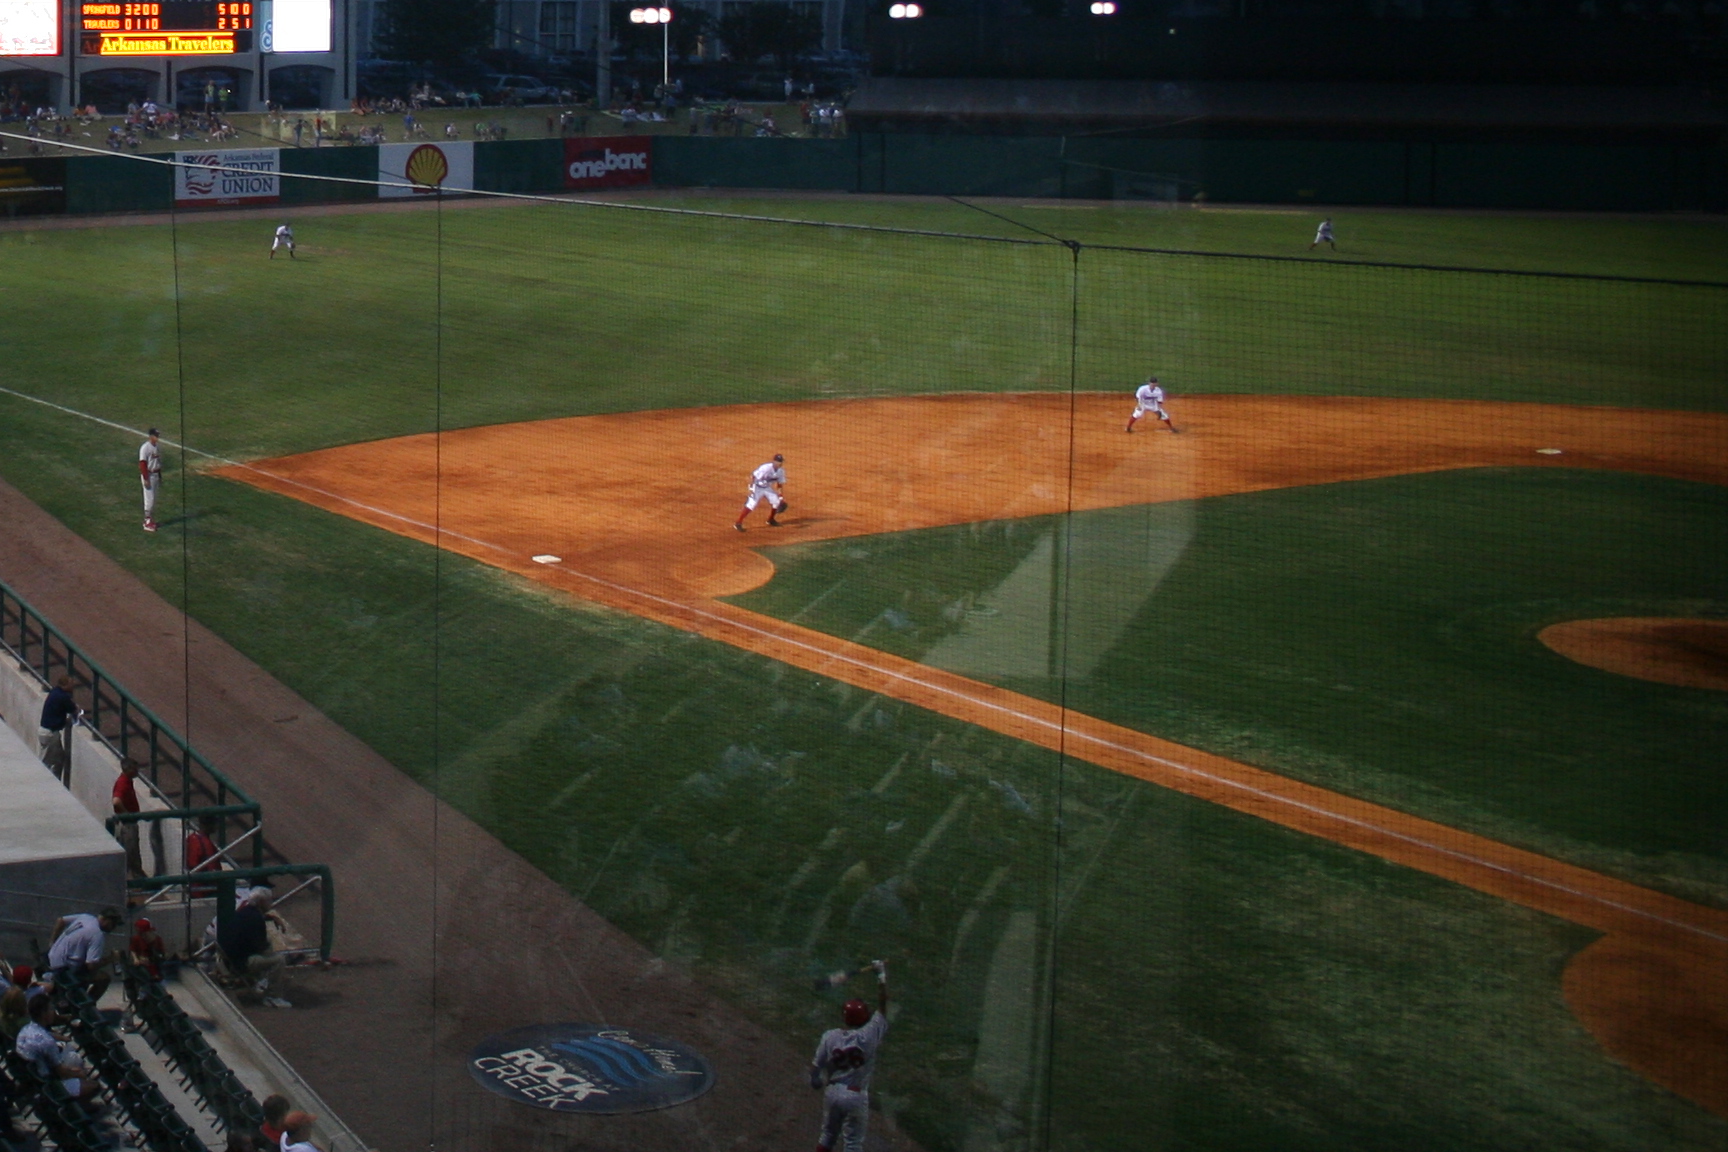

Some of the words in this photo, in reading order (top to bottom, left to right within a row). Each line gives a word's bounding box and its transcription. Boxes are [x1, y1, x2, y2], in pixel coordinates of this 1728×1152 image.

[125, 4, 131, 15] 3
[134, 4, 140, 15] 2
[143, 4, 149, 15] 0
[152, 4, 158, 15] 0
[219, 4, 225, 15] 5
[243, 4, 250, 15] 0
[125, 18, 131, 29] 0
[152, 18, 158, 29] 0
[219, 18, 225, 29] 2
[232, 18, 239, 29] 5
[101, 36, 166, 51] Arkansas
[168, 36, 233, 51] Travelers
[569, 148, 647, 179] onebanc
[222, 178, 274, 194] UNION
[500, 1048, 609, 1101] ROCK
[474, 1057, 576, 1109] CREEK
